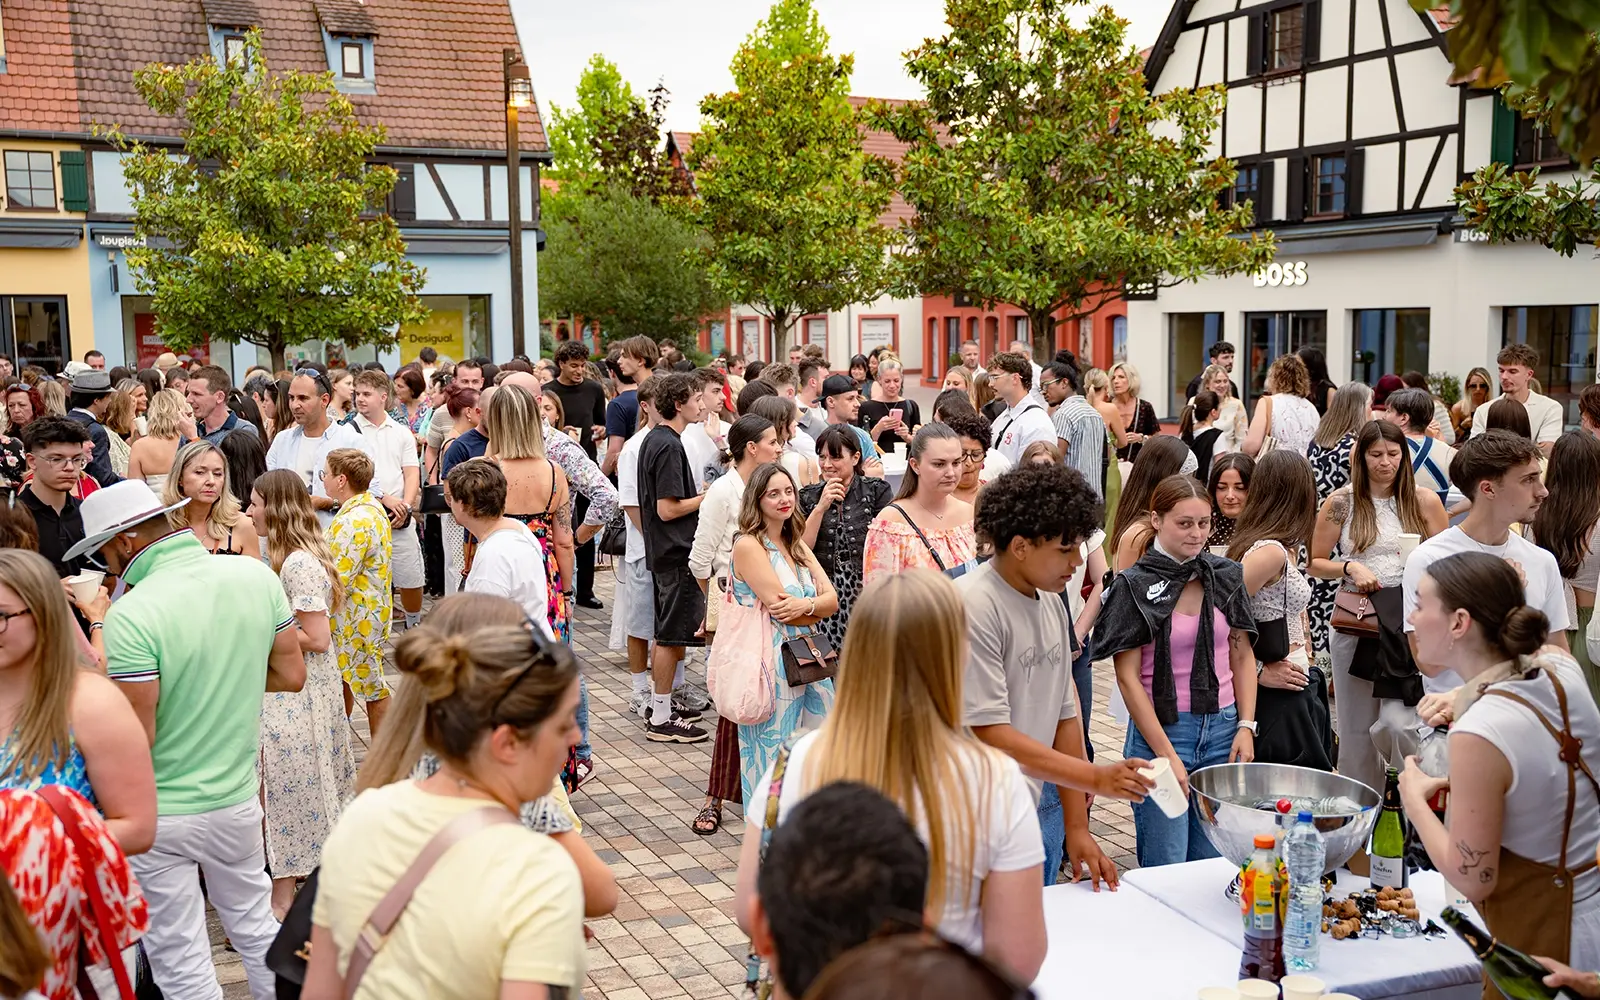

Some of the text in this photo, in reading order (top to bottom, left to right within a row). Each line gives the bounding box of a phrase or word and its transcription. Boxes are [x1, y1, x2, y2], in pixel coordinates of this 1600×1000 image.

[1460, 229, 1489, 242] BOS
[1253, 261, 1308, 287] BOSS
[1148, 580, 1166, 594] NIKE
